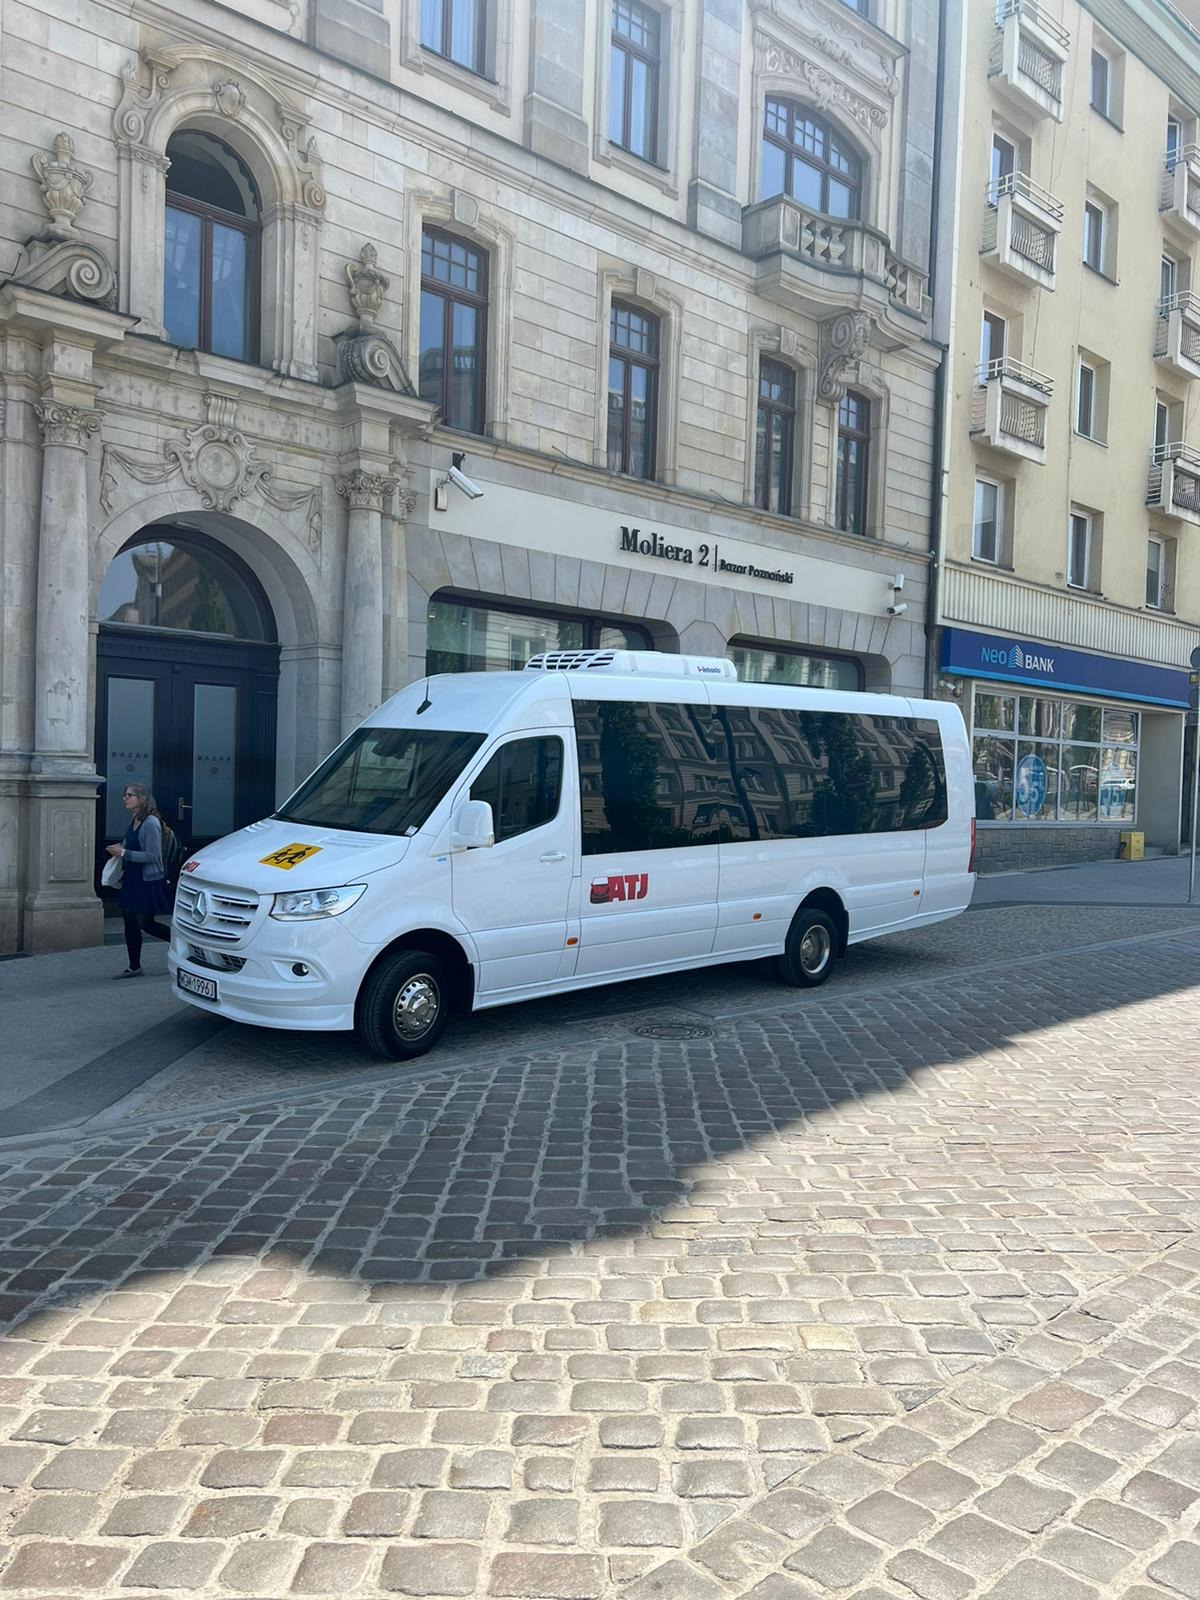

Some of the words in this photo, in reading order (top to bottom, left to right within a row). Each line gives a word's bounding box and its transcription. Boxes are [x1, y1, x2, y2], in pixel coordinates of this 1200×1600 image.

[620, 526, 693, 564] Moliera
[698, 543, 709, 567] 2
[719, 558, 747, 575] Bazar
[748, 564, 794, 584] Poznański
[981, 646, 1007, 665] Neo
[1025, 654, 1055, 673] BANK
[608, 873, 649, 903] ATJ
